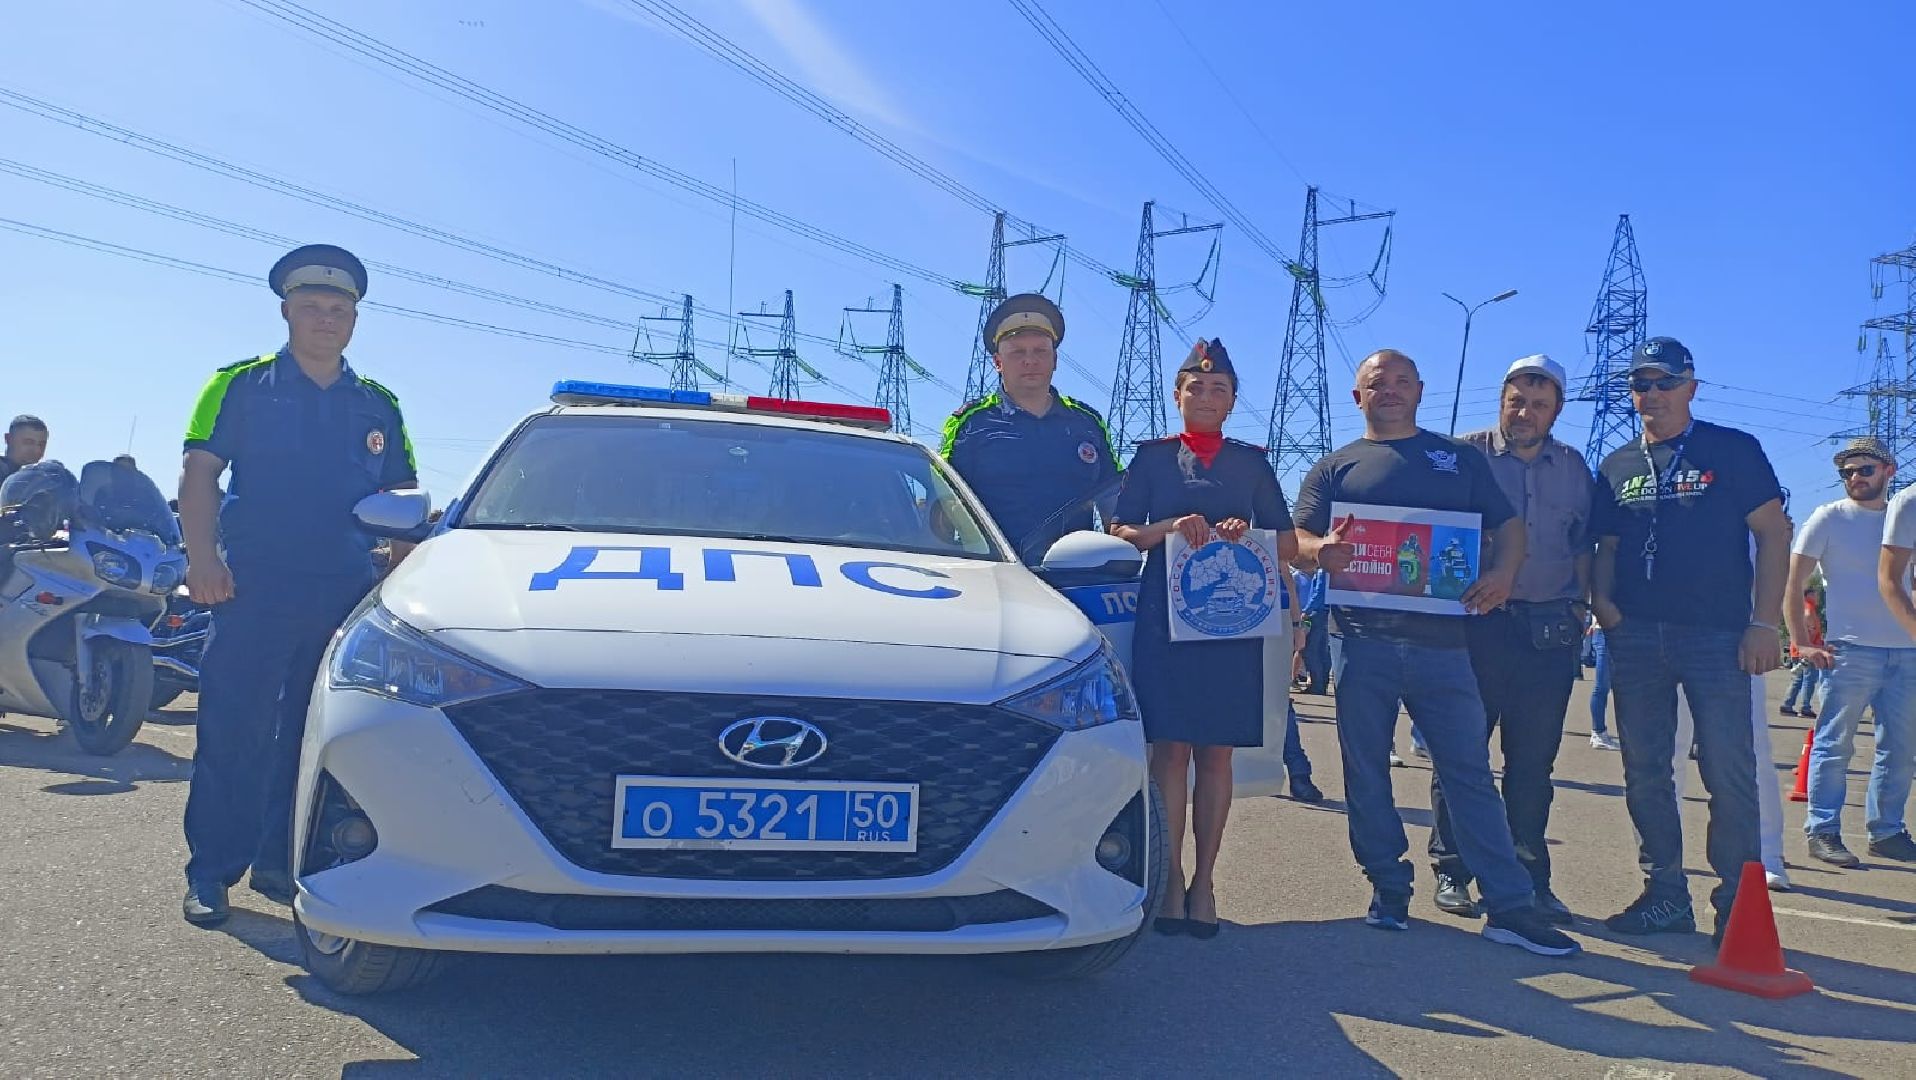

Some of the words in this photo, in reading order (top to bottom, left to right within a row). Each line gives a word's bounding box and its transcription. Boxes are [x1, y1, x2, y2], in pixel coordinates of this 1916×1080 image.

[1367, 544, 1392, 558] СЕБЯ
[529, 546, 963, 600] ДПС
[1343, 560, 1392, 575] СТОЙНО
[694, 791, 818, 840] 5321
[852, 792, 900, 829] 50
[857, 831, 892, 842] RUS
